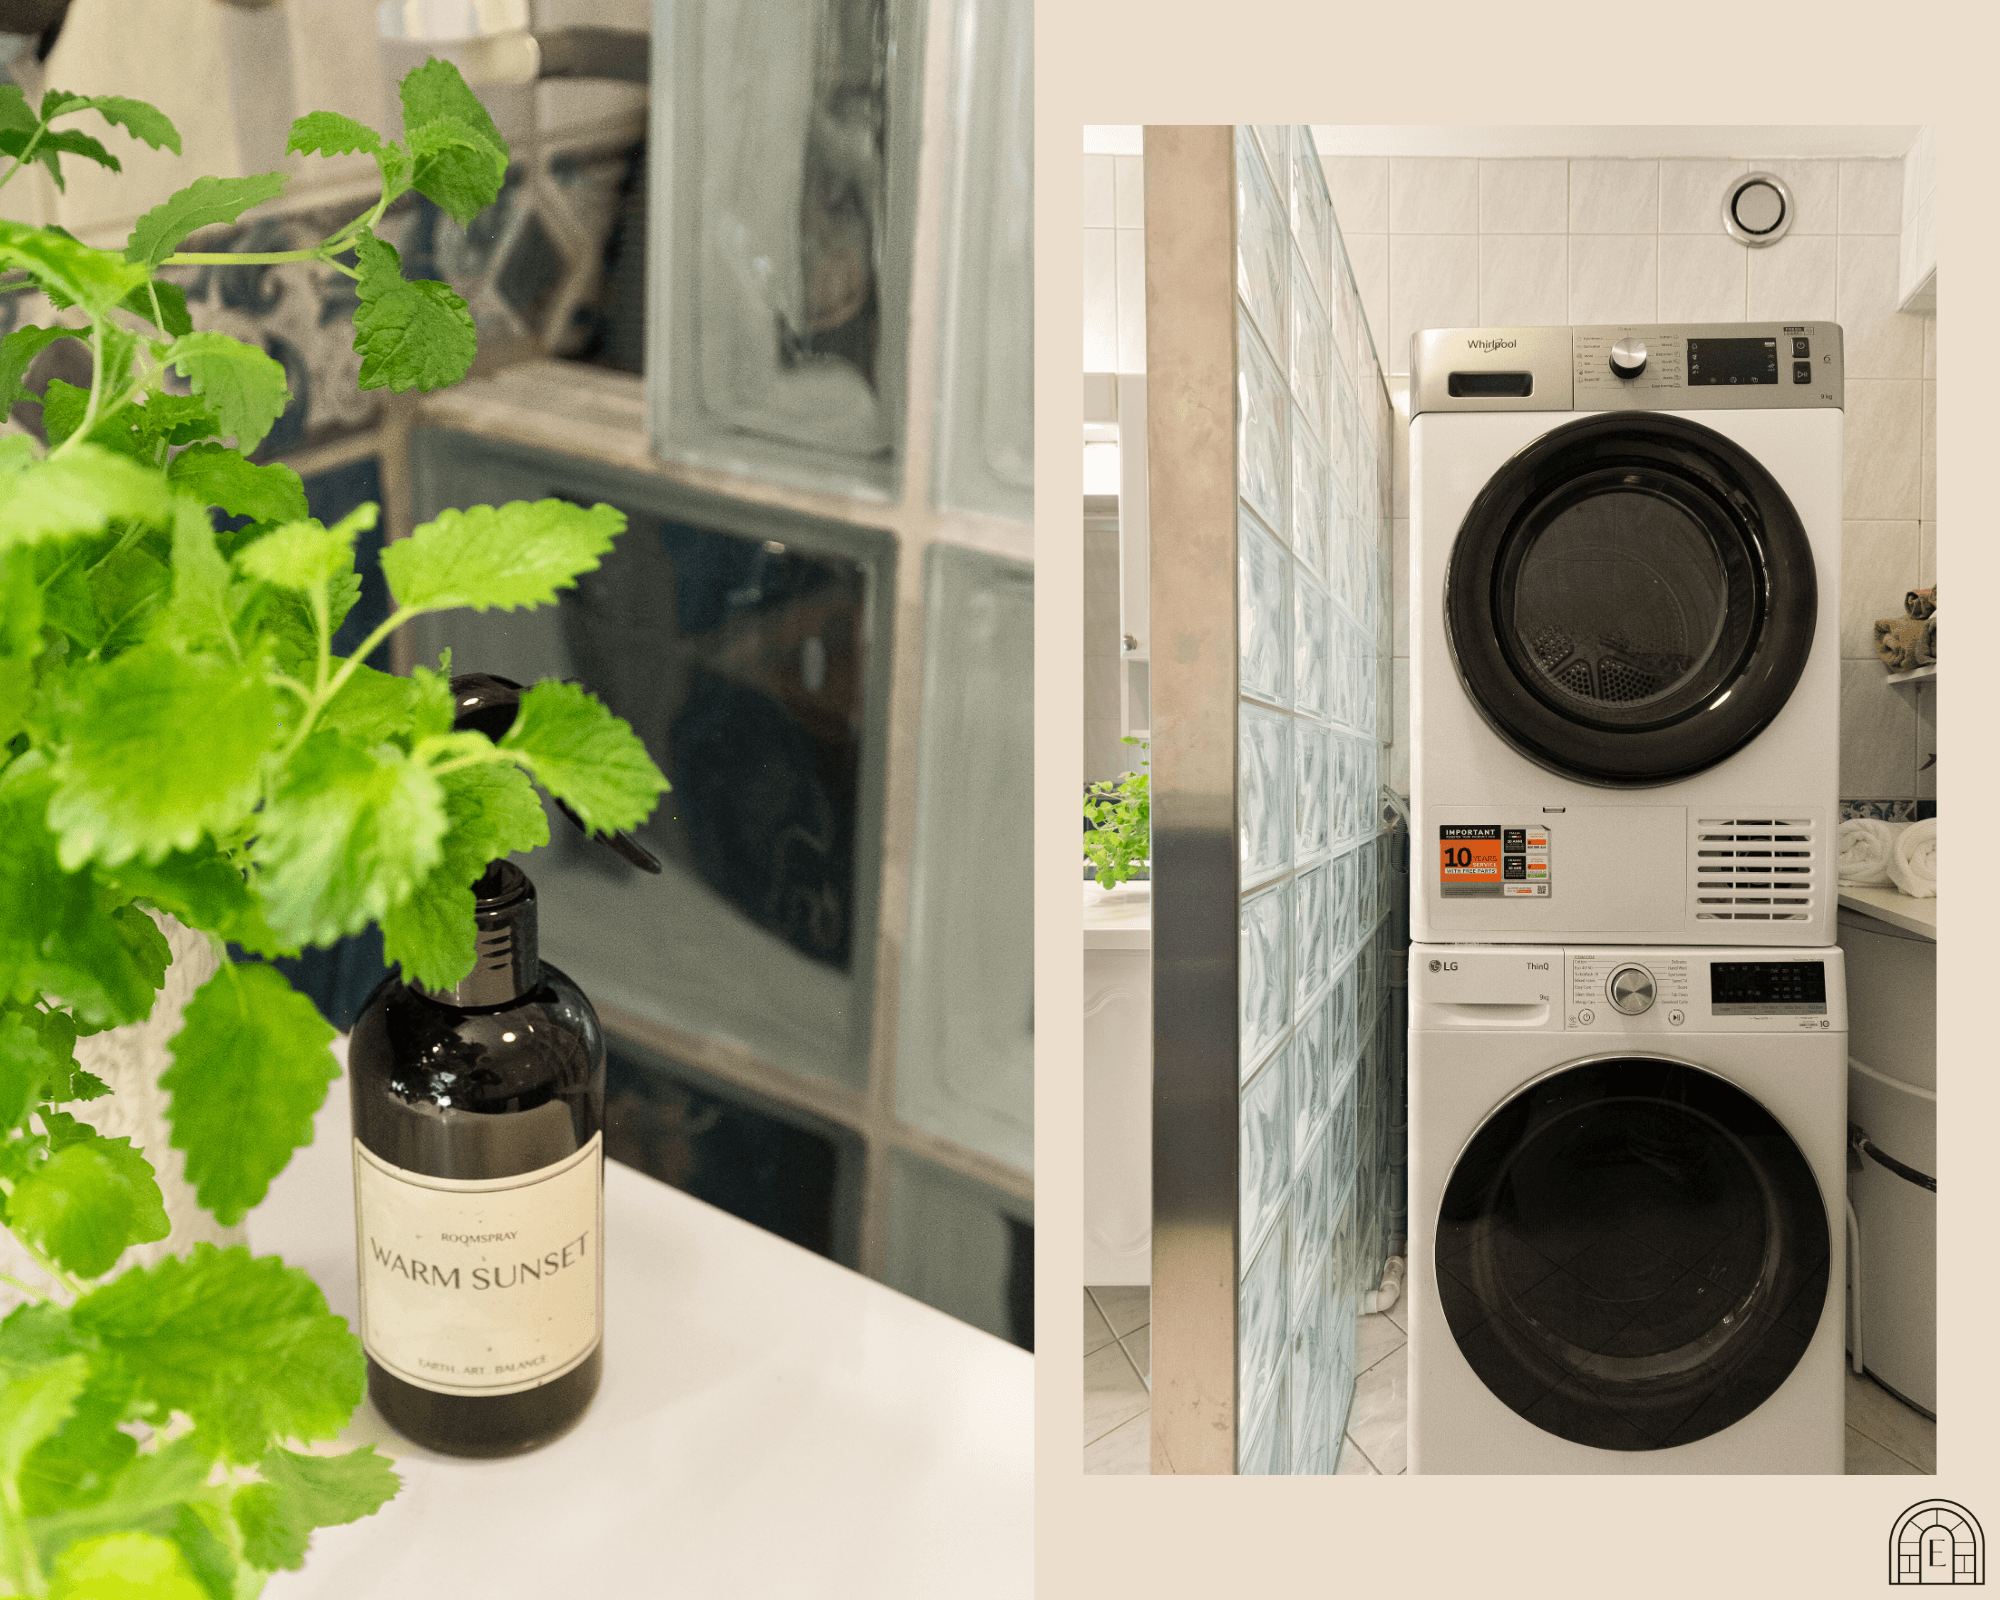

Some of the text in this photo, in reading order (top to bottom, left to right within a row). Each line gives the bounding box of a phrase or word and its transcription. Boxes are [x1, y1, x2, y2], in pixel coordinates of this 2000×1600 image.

[1467, 338, 1517, 353] Whirlpool
[1825, 393, 1833, 401] kg
[1444, 847, 1472, 867] 10
[1443, 962, 1458, 971] LG
[1526, 962, 1549, 971] ThinQ
[441, 1230, 518, 1244] ROOMSPRAY
[370, 1229, 590, 1290] WARM SUNSET
[418, 1354, 547, 1376] EARTH ART BALANCE
